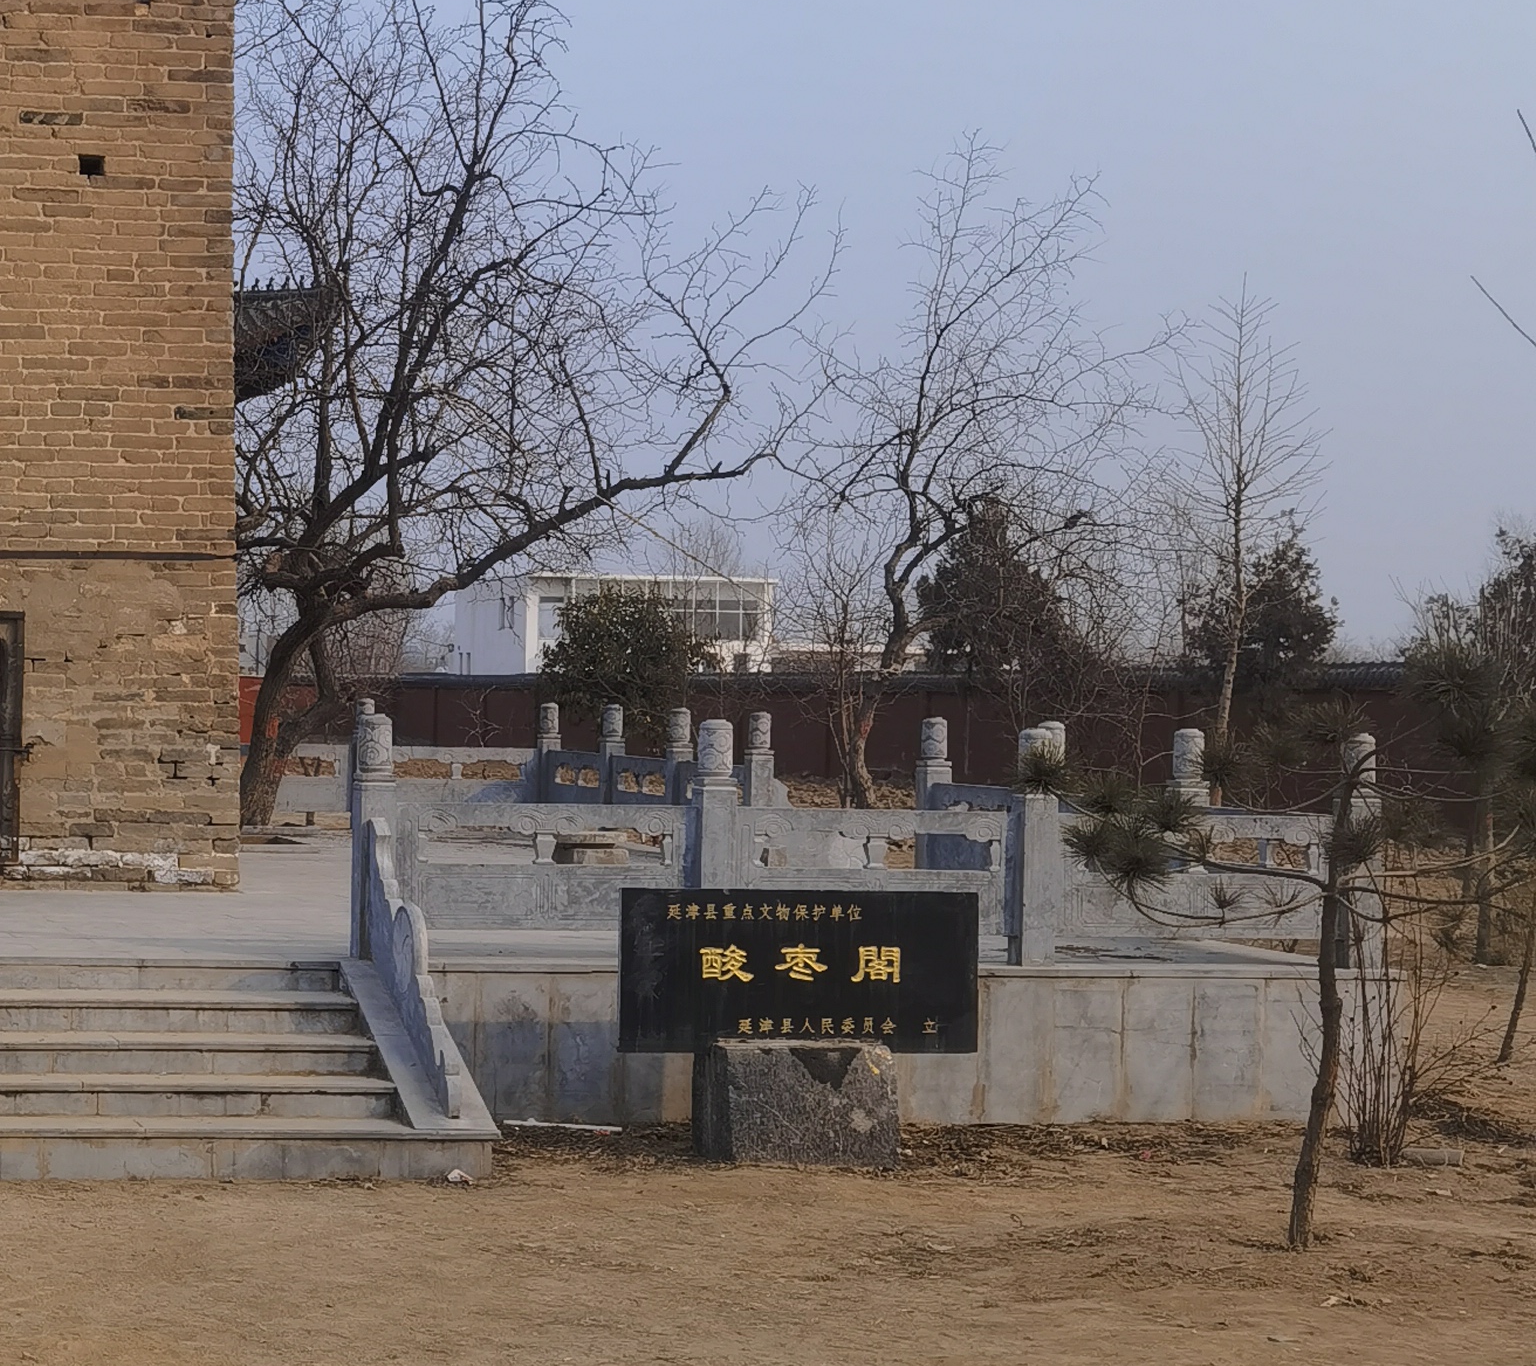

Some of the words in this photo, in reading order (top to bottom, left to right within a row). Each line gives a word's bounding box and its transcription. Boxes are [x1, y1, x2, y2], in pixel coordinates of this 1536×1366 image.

[667, 903, 863, 922] 延津县重点文物保护单位
[737, 1017, 897, 1035] 延津县人民委员会
[922, 1018, 937, 1034] 立
